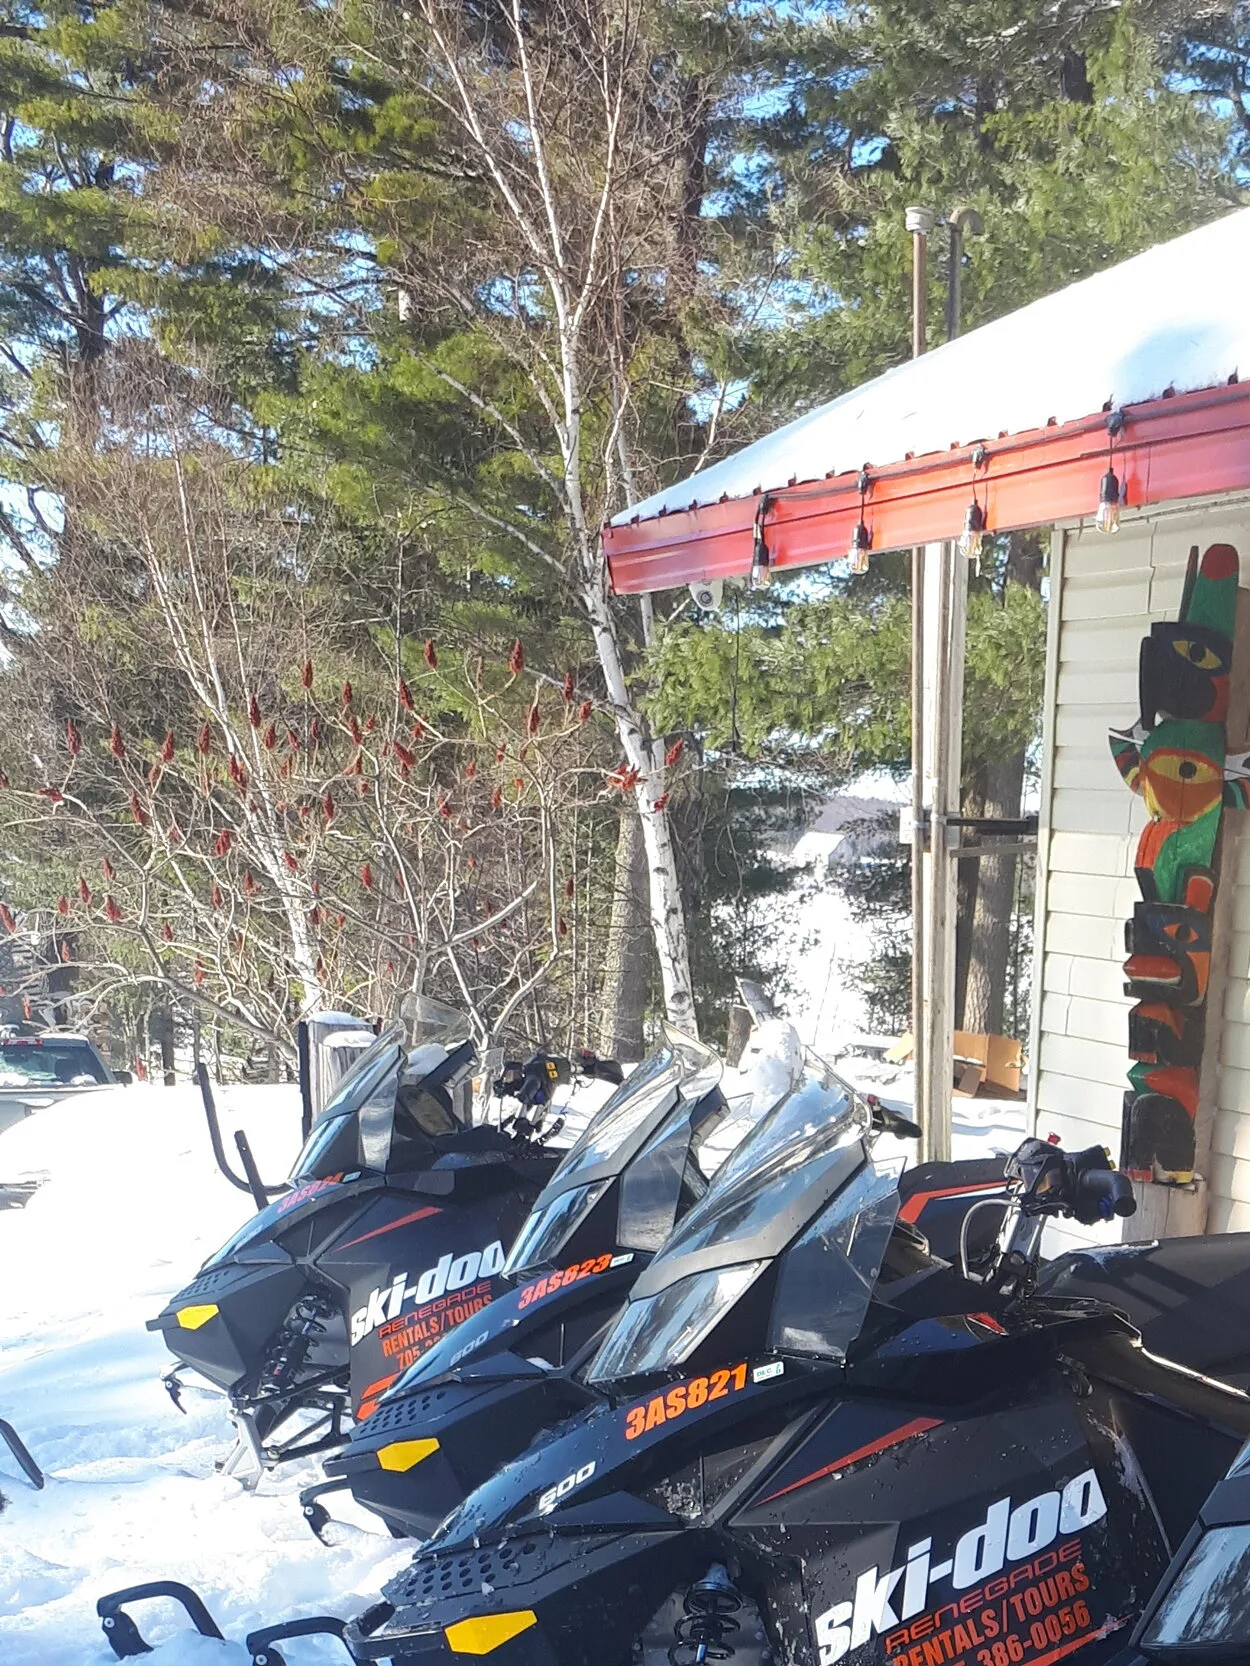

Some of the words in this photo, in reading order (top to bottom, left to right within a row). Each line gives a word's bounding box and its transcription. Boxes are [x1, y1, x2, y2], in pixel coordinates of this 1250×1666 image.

[351, 1240, 506, 1347] ski-doo
[378, 1280, 492, 1339] RENEGADE
[518, 1253, 613, 1310] 3AS823
[450, 1331, 489, 1365] 600
[625, 1362, 748, 1440] 3AS821
[538, 1461, 596, 1513] 600
[885, 1538, 1082, 1655] RENEGADE
